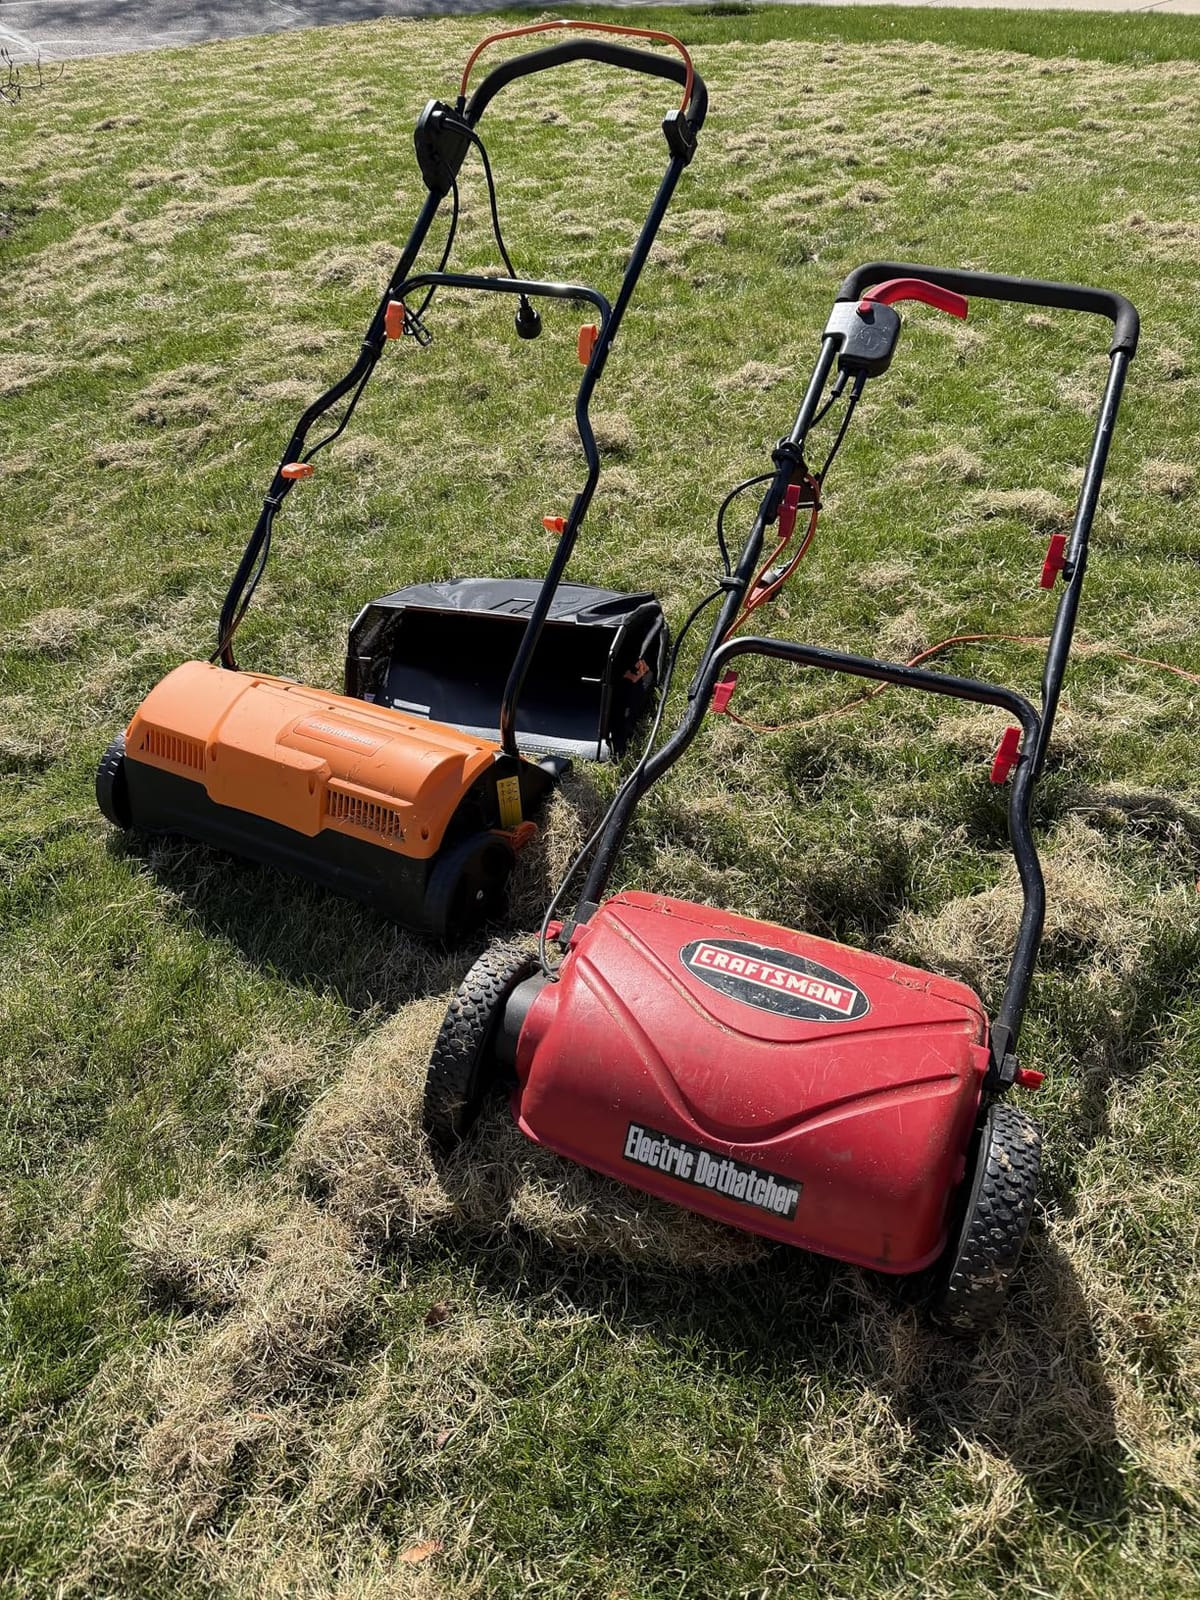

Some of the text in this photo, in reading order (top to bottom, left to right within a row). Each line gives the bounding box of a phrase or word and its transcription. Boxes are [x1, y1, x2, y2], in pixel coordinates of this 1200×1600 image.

[700, 949, 842, 1004] CRAFTSMAN
[625, 1125, 799, 1215] Electric Dethatcher
